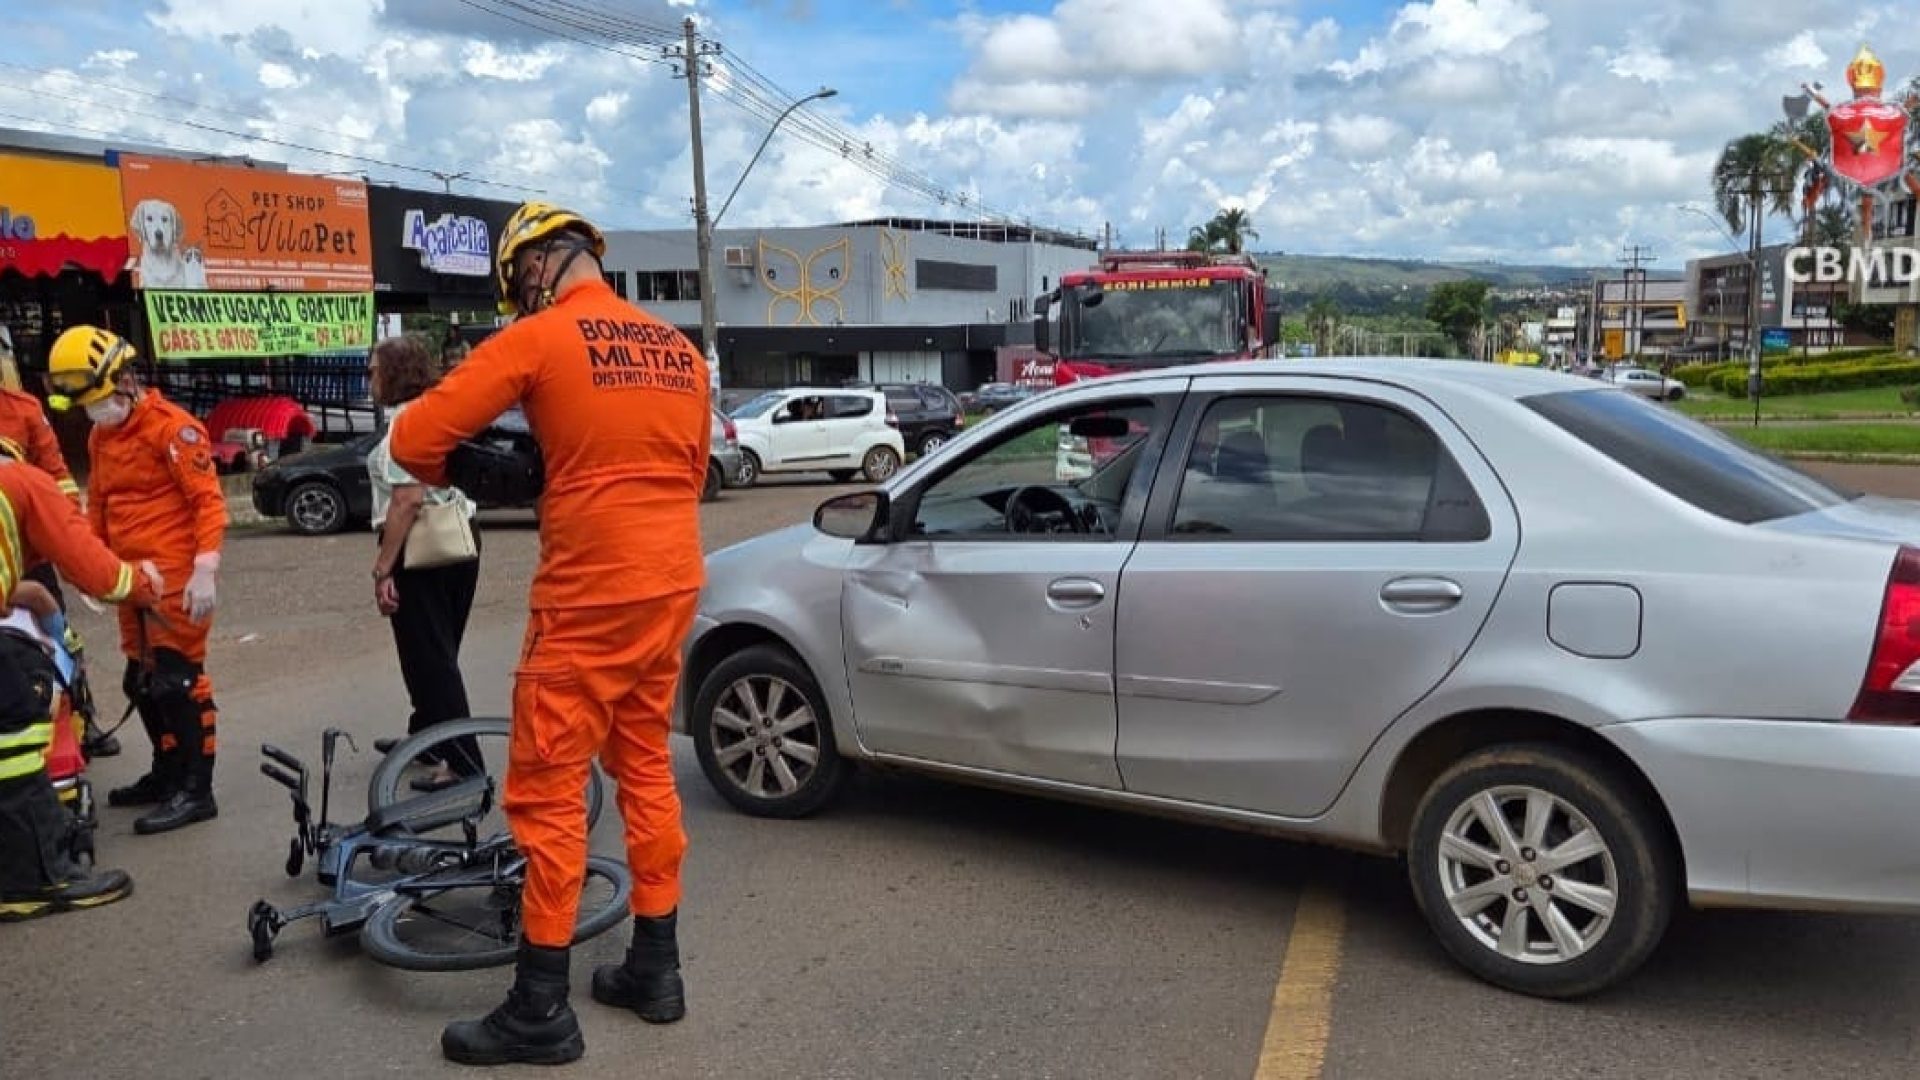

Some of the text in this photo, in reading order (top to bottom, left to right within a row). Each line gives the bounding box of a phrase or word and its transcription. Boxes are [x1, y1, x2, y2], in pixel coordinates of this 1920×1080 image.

[252, 191, 280, 207] PET
[287, 194, 325, 212] SHOP
[296, 295, 367, 323] GRATUITA
[587, 344, 695, 373] MILITAR
[592, 371, 653, 387] DISTRITO
